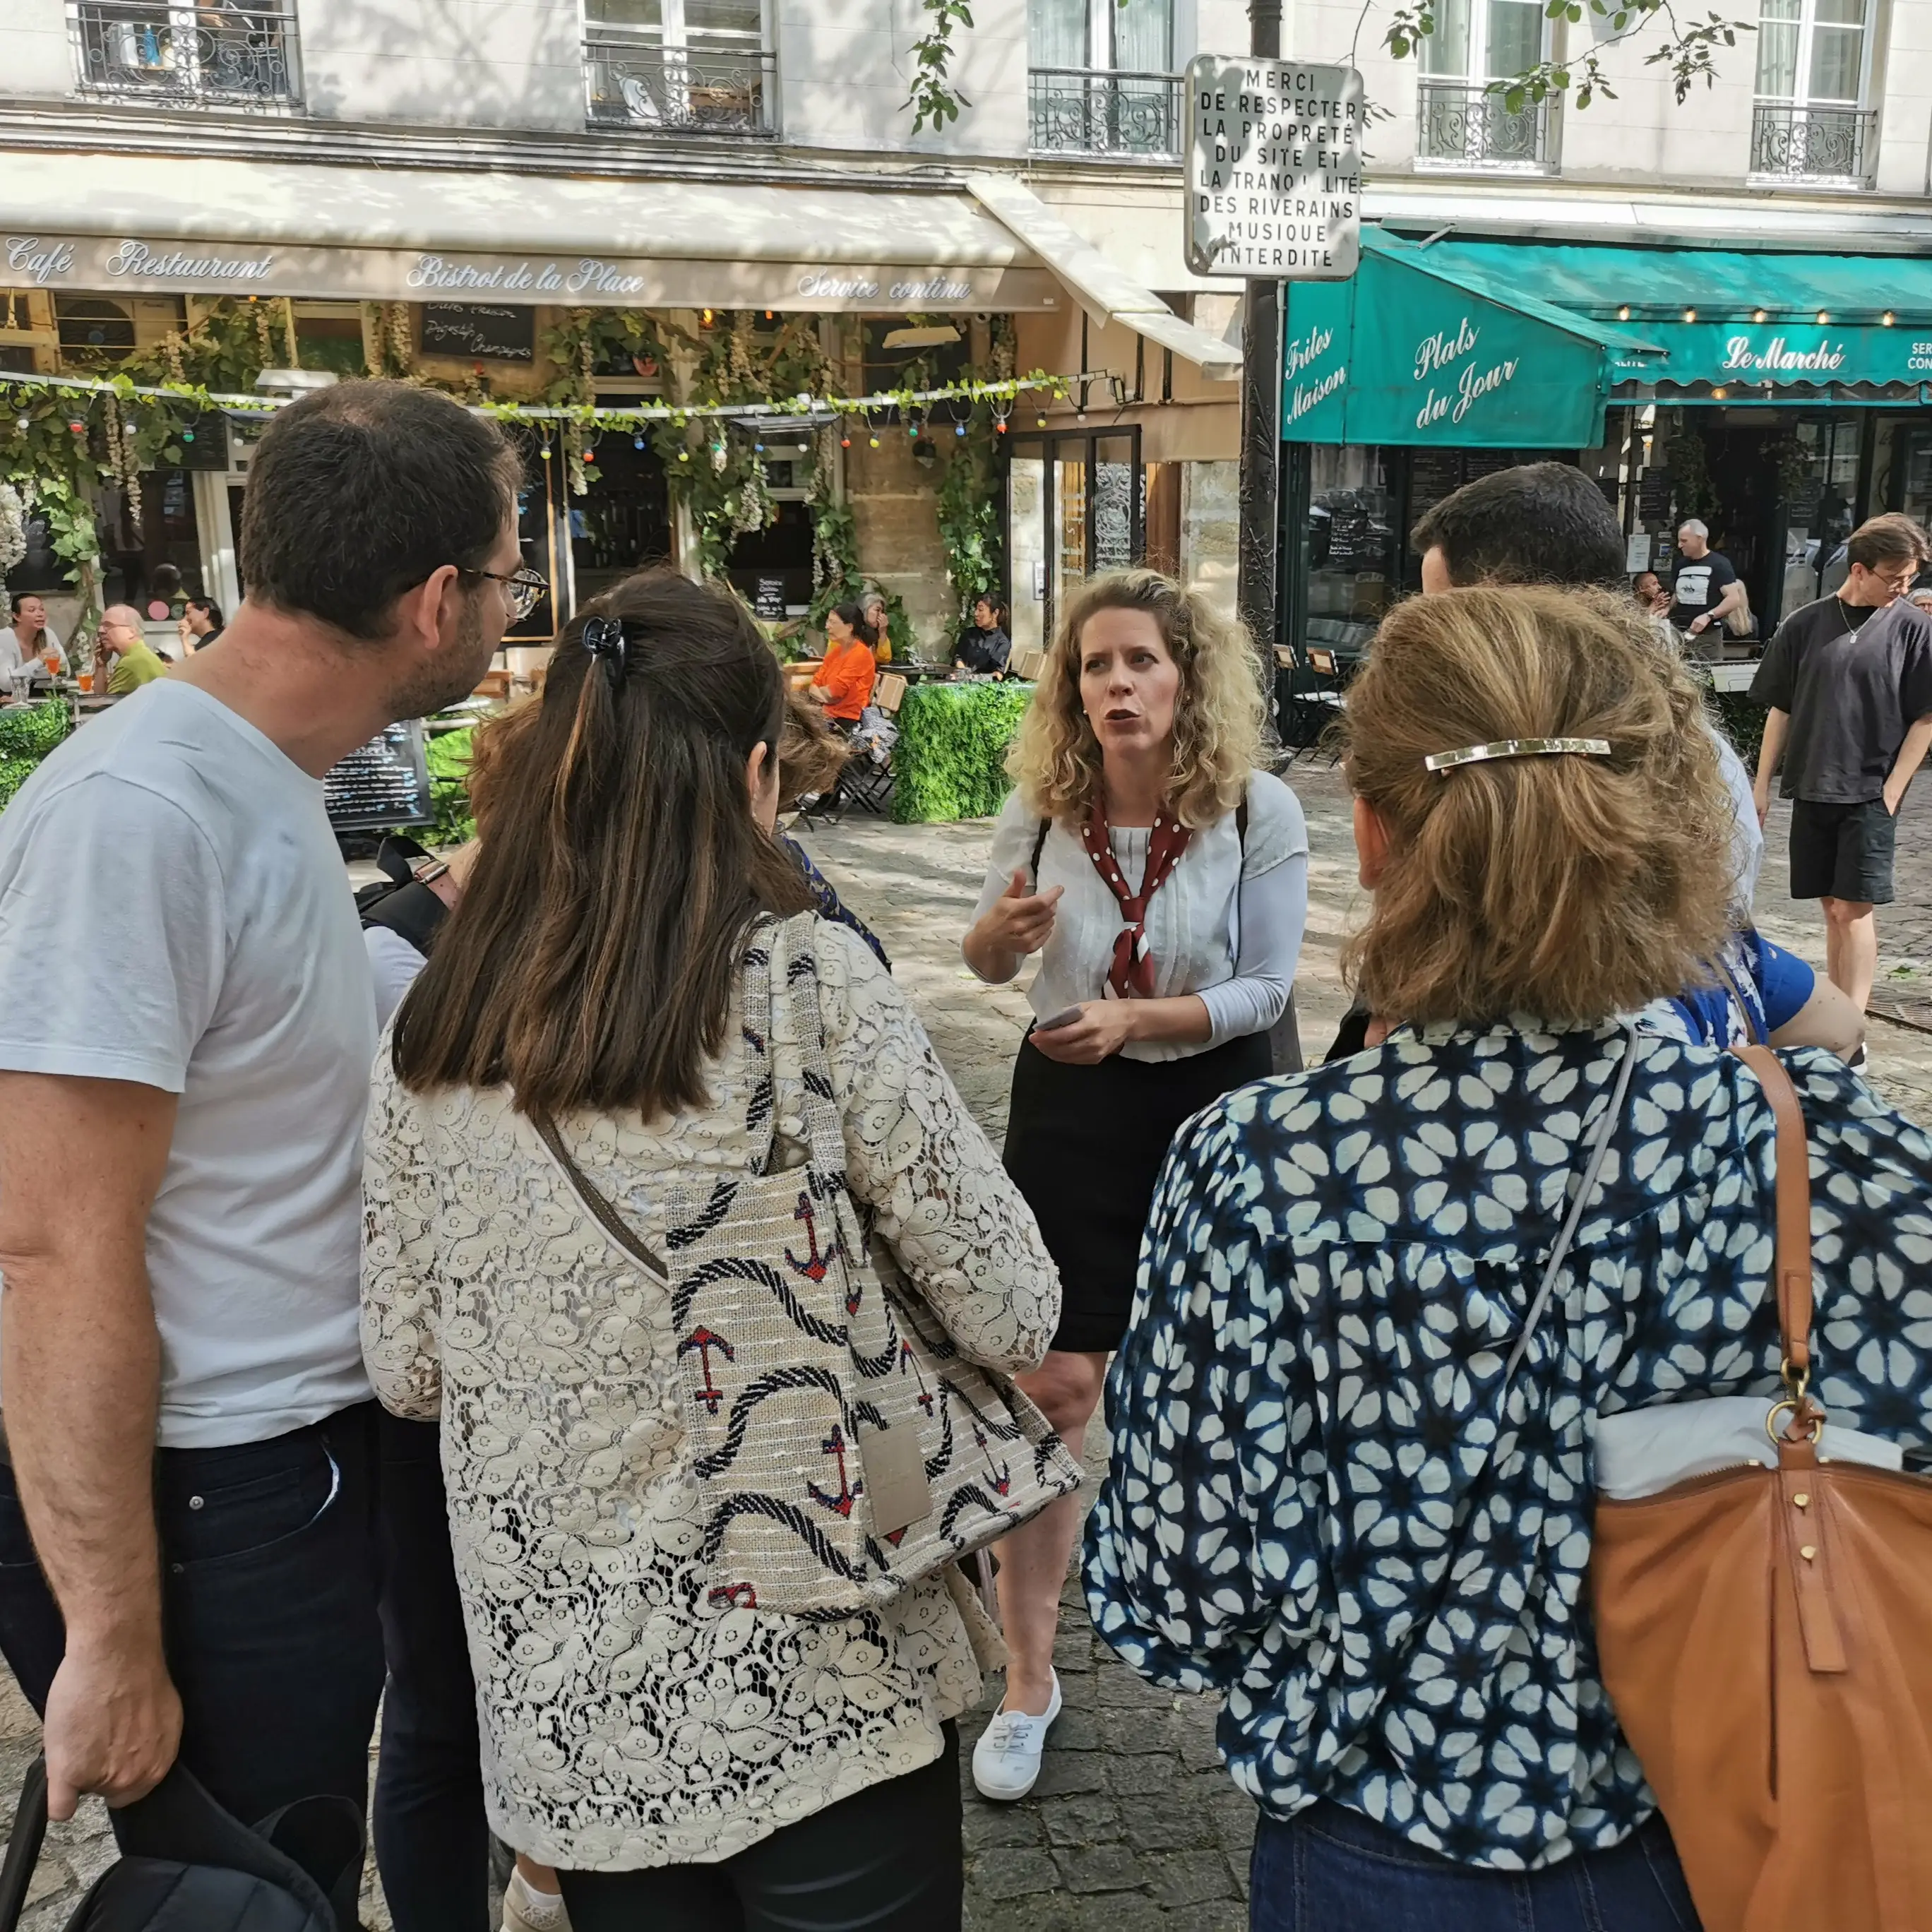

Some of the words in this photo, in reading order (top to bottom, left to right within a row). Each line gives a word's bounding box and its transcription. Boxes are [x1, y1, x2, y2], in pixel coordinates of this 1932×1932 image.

[1246, 69, 1314, 92] MERCI
[1201, 93, 1226, 112] DE
[1239, 95, 1356, 119] RESPECTER
[1203, 118, 1226, 137] LA
[1242, 121, 1353, 145] PROPRETÉ
[1216, 146, 1241, 164] DU
[1258, 148, 1302, 167] SITE
[1318, 150, 1340, 169] ET
[1200, 169, 1222, 189] LA
[1233, 170, 1358, 194] TRANQLITÉ
[1200, 195, 1236, 213] DES
[1249, 197, 1353, 218] RIVERAINS
[1229, 221, 1325, 242] MUSIQUE
[6, 237, 74, 284] Café
[105, 239, 273, 280] Restaurant
[1221, 248, 1332, 267] INTERDITE
[405, 254, 505, 289] Bistrot
[502, 262, 532, 290] de
[535, 263, 565, 292] la
[566, 257, 645, 294] Place
[797, 266, 879, 299] Service
[888, 275, 972, 299] continu
[1285, 326, 1334, 381] Frites
[1414, 316, 1481, 381] Plats
[1722, 335, 1758, 369] Le
[1754, 337, 1847, 370] Marché
[1907, 357, 1932, 369] CON
[1287, 365, 1347, 425] Maison
[1416, 388, 1455, 429] du
[1452, 357, 1520, 424] Jour
